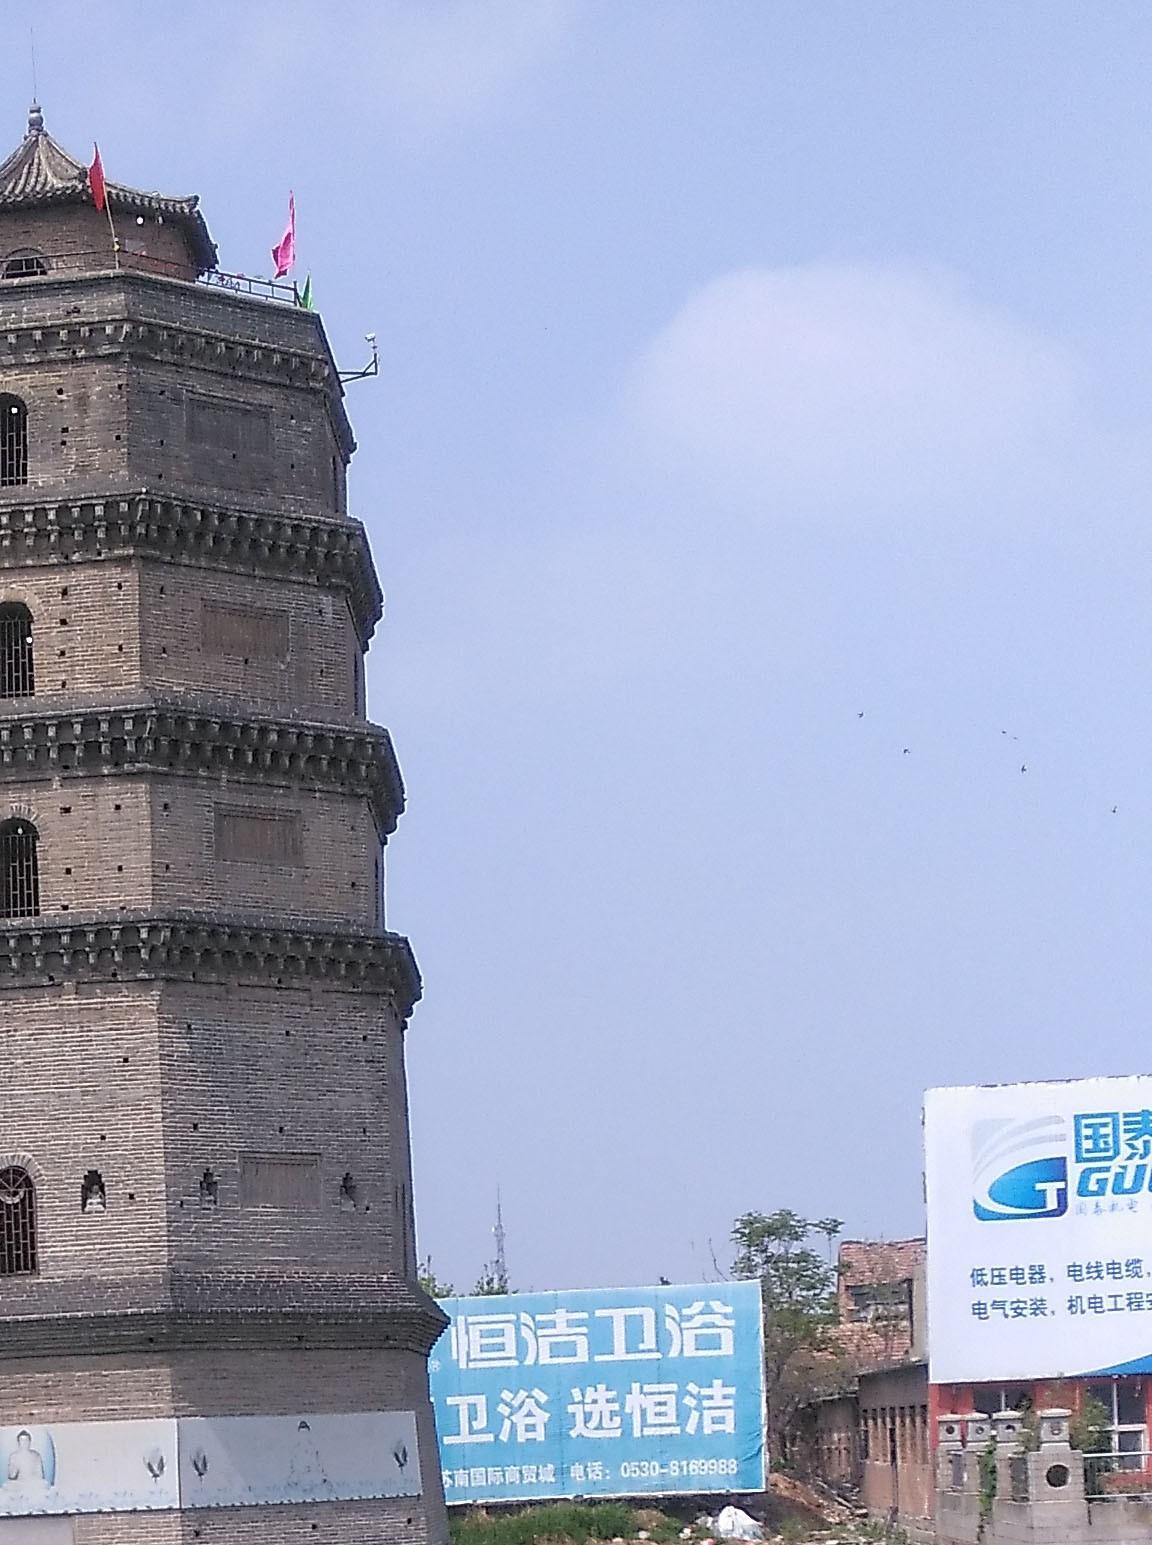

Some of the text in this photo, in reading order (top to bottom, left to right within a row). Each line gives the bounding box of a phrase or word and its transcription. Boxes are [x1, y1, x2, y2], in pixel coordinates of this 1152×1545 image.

[1077, 1164, 1152, 1197] GU
[972, 1291, 1152, 1320] 电气安装，机电工程
[451, 1301, 735, 1369] 恒洁卫浴
[443, 1379, 737, 1445] 卫浴 选恒洁
